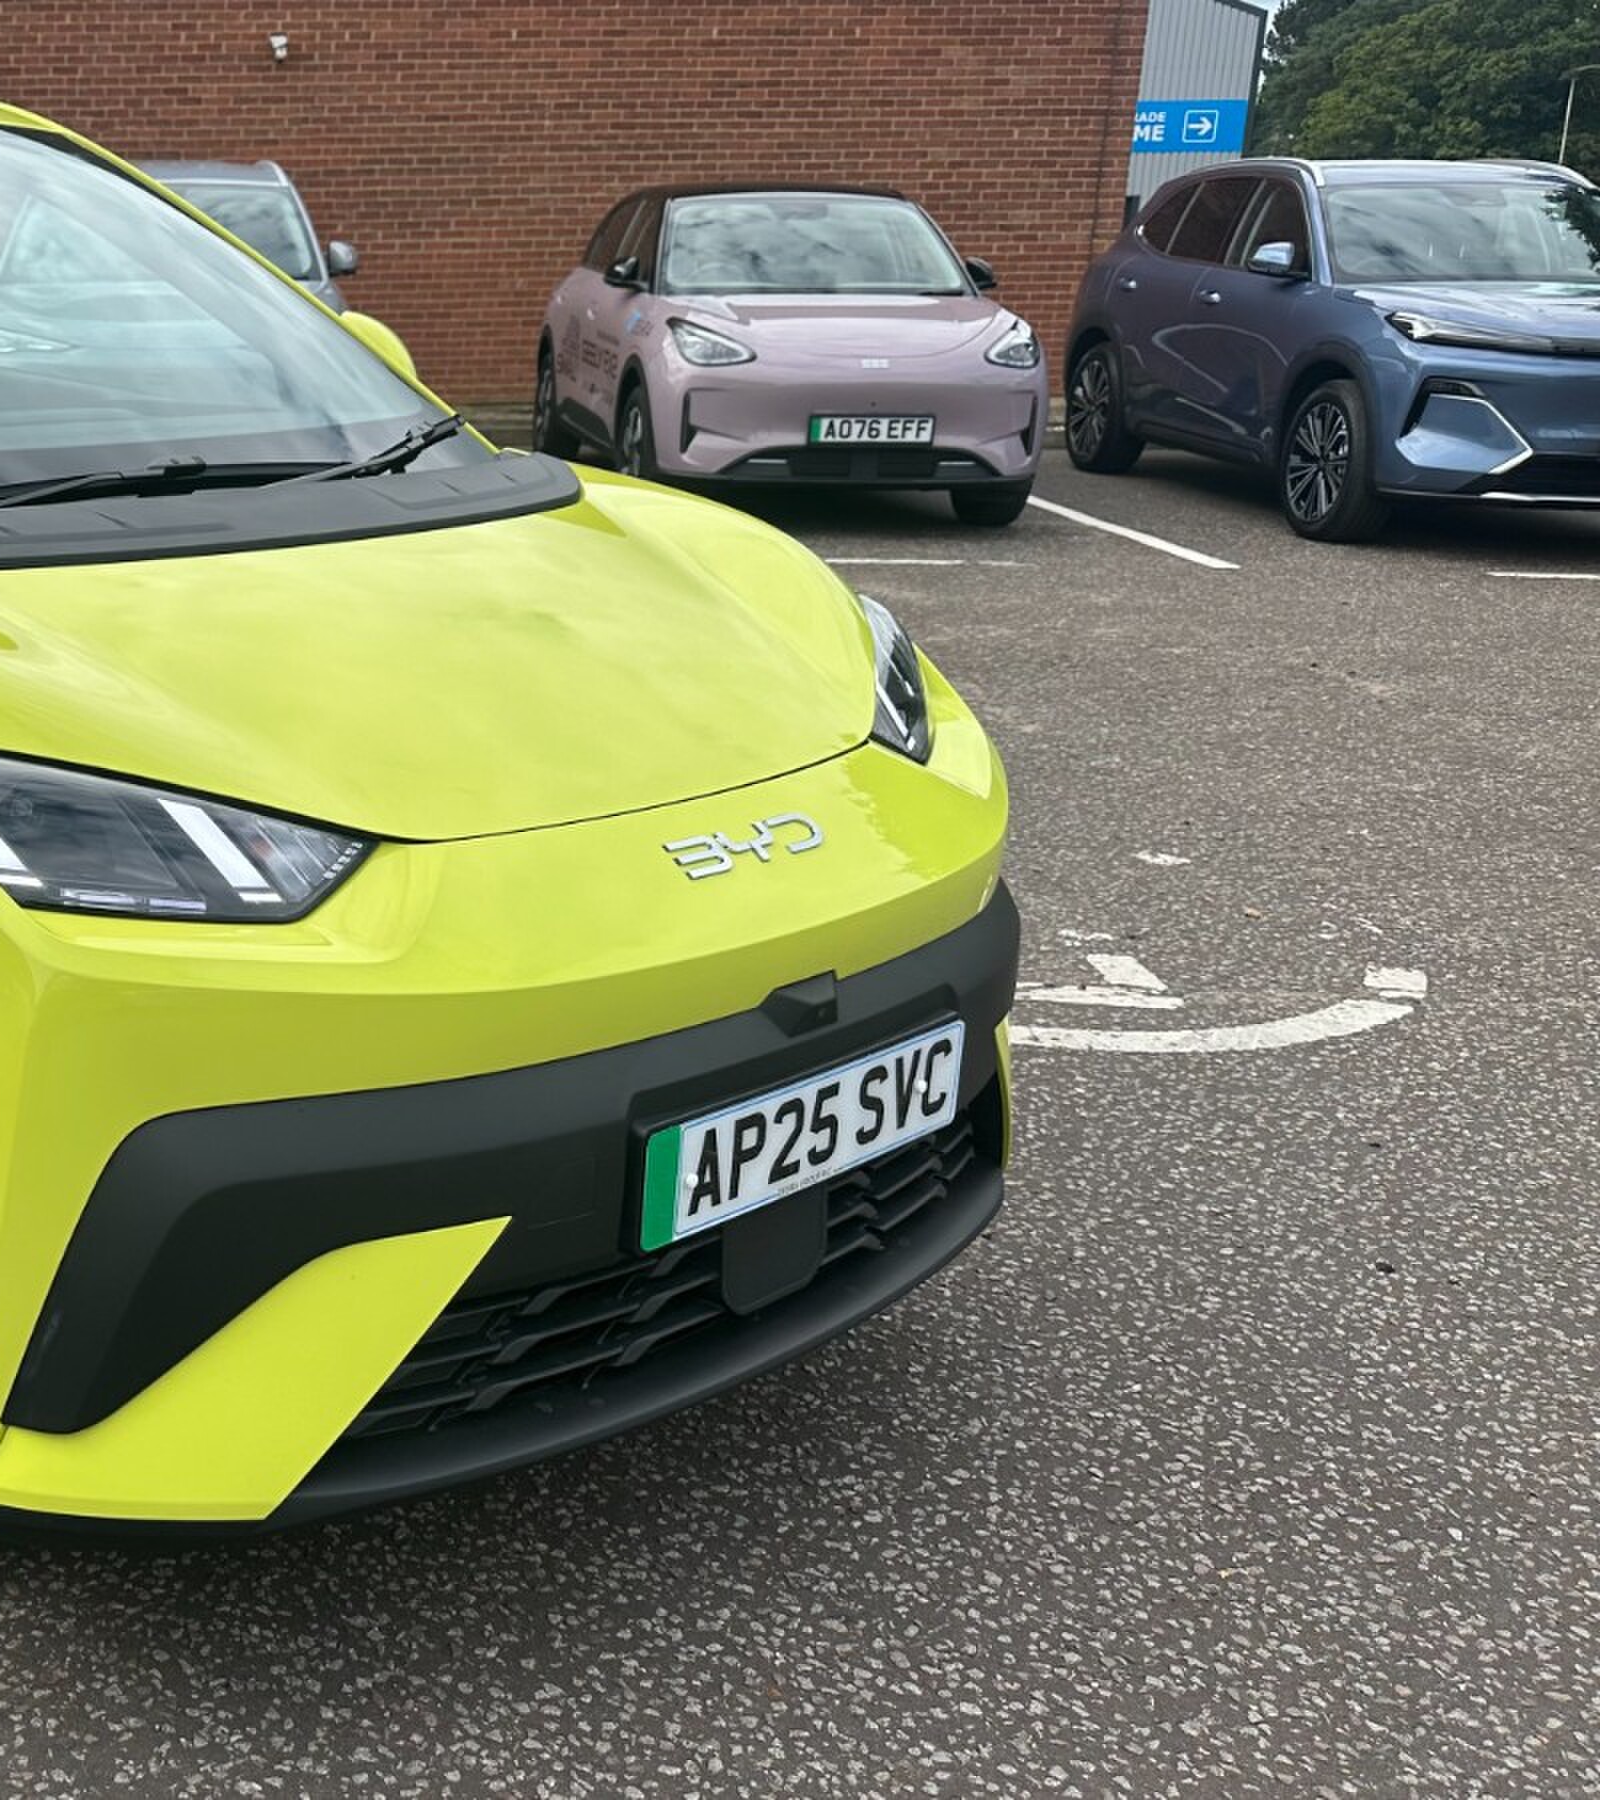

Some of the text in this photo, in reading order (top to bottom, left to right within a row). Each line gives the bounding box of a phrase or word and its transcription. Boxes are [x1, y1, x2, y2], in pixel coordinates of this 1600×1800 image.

[824, 419, 929, 439] AO76 EFF
[662, 813, 823, 880] BYD
[687, 1038, 953, 1217] AP25 SVC
